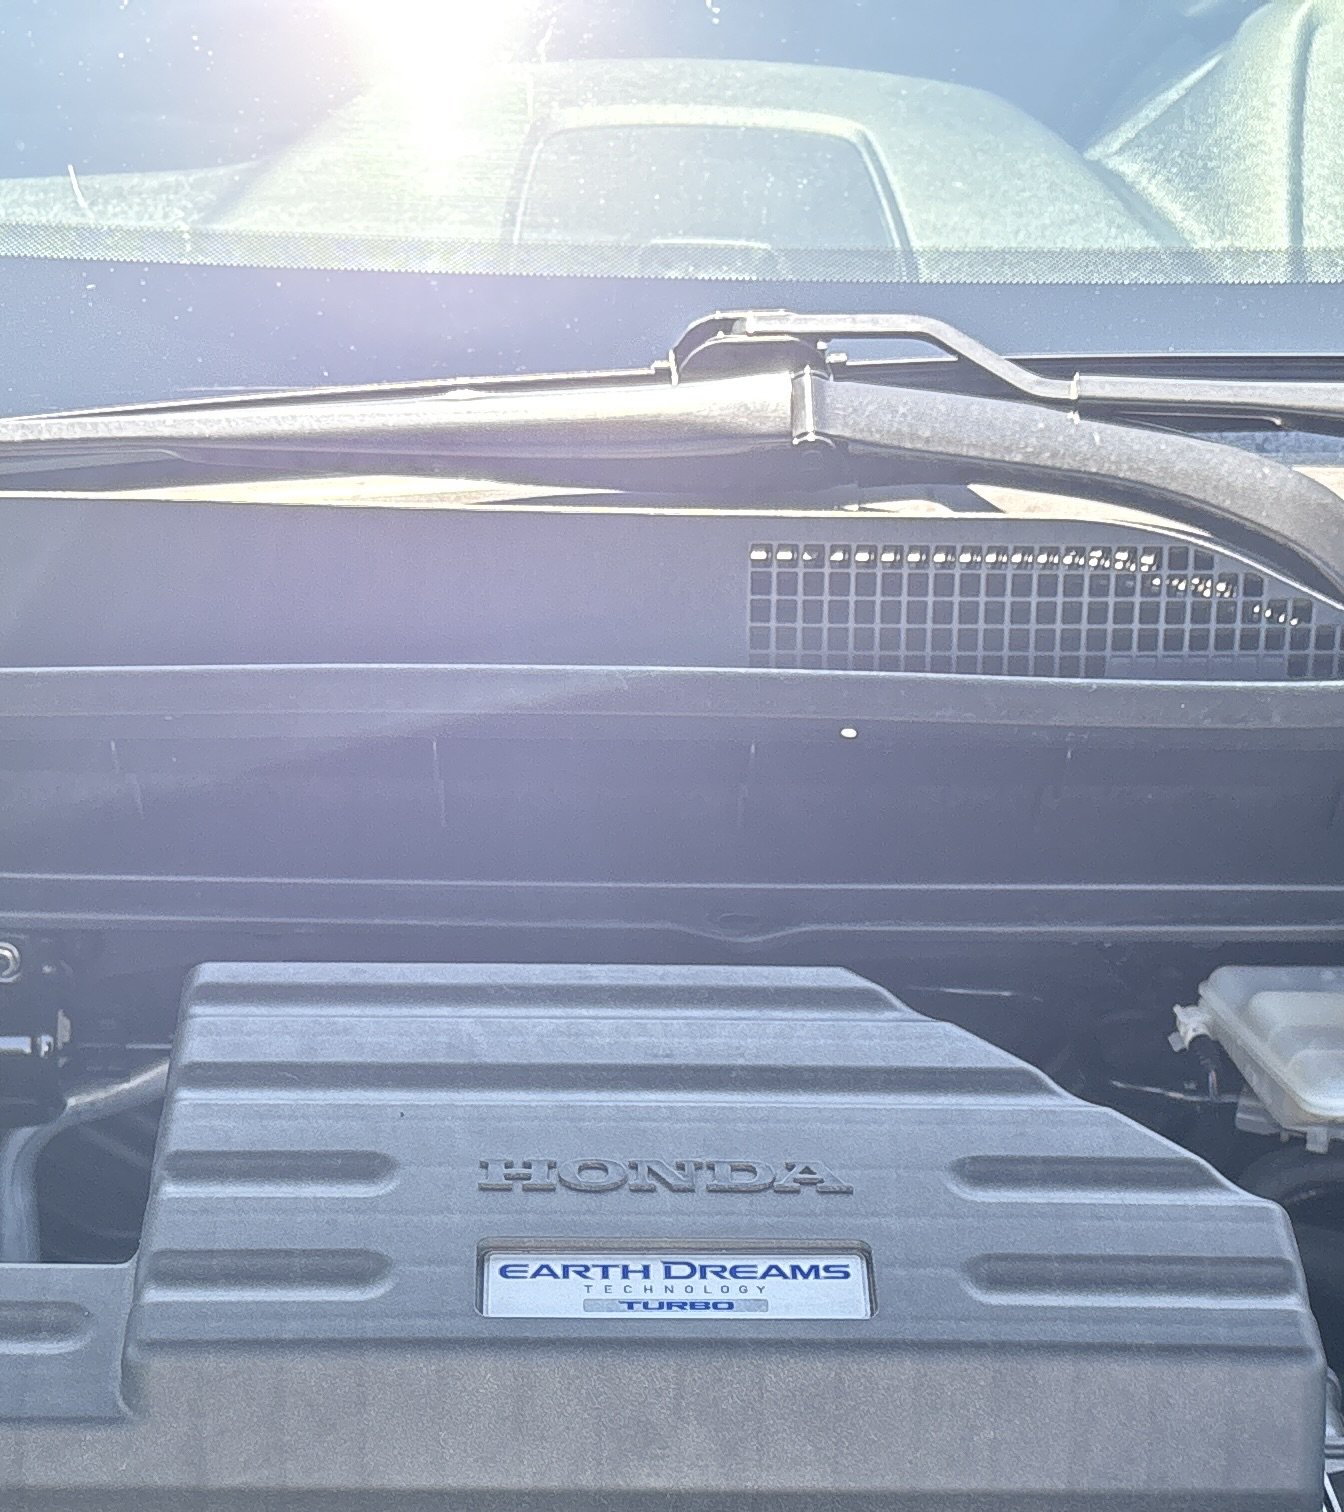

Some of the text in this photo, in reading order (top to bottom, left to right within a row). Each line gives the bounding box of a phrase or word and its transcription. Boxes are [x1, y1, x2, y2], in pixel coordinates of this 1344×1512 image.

[477, 1158, 855, 1196] HONDA
[498, 1260, 852, 1281] EARTH DREAMS
[583, 1284, 768, 1295] TECHNOLOGY
[618, 1300, 736, 1312] TURBO
